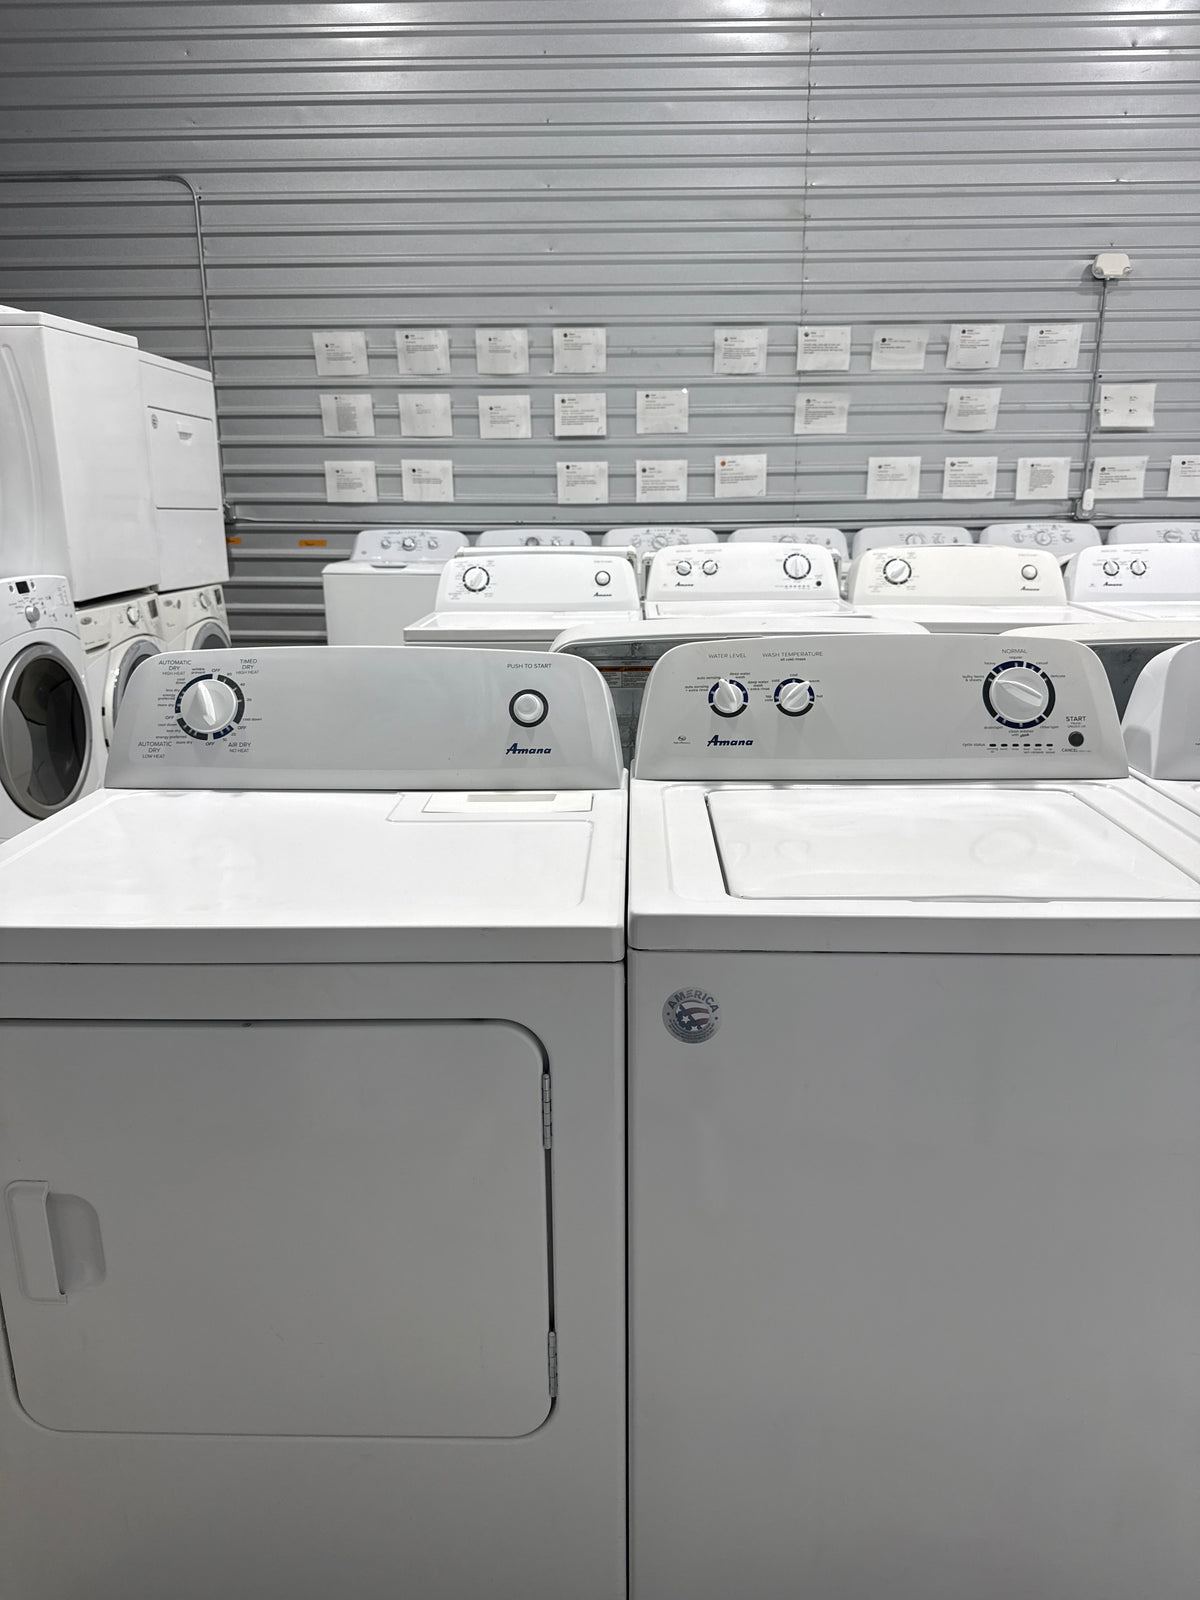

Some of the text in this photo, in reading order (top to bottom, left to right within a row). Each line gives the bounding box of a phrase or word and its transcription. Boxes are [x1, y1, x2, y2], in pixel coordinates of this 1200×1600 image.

[707, 735, 753, 746] Amana
[506, 743, 551, 754] Amana
[668, 989, 719, 1013] AMERICA
